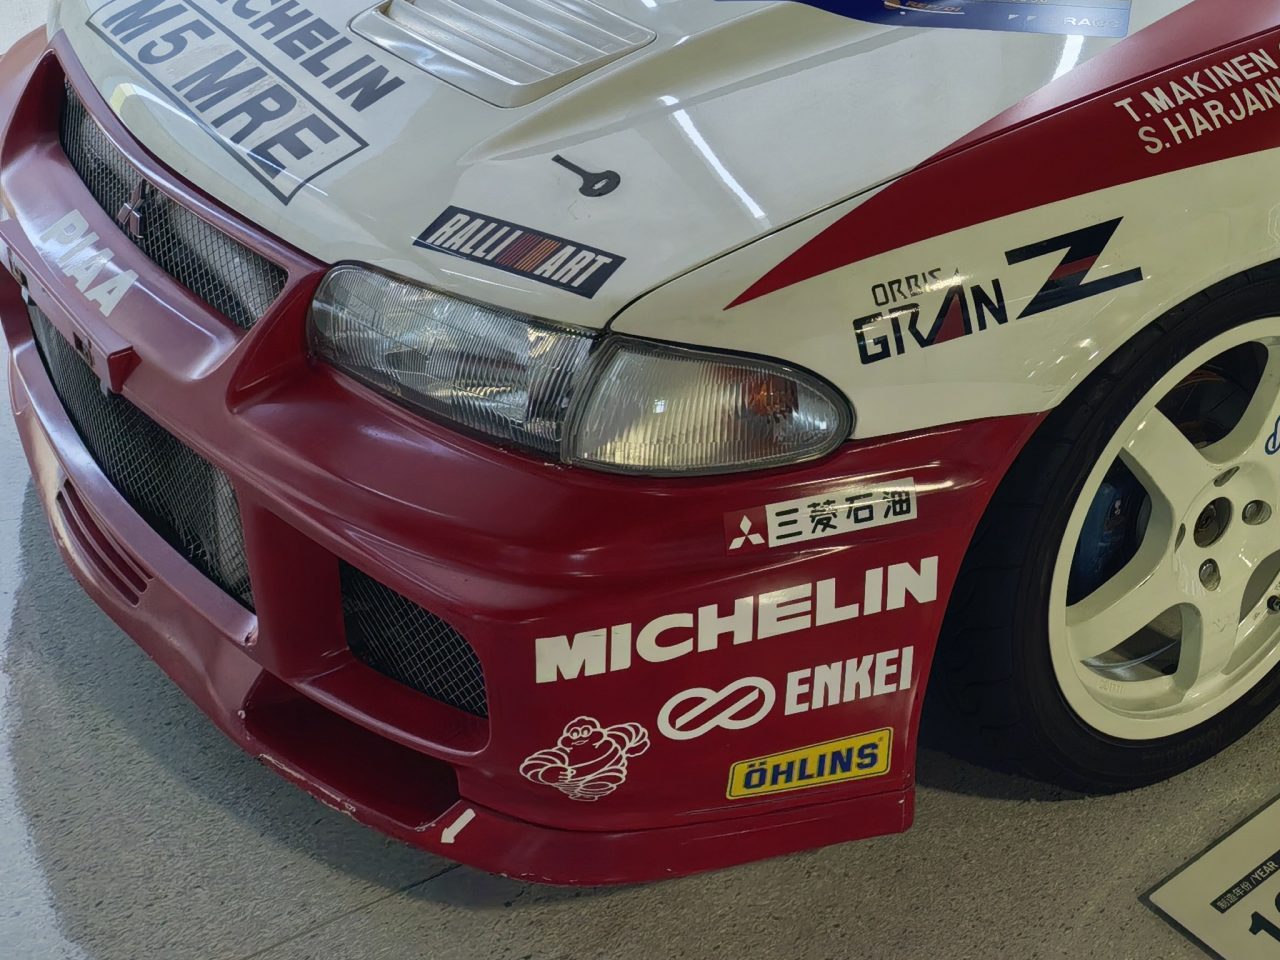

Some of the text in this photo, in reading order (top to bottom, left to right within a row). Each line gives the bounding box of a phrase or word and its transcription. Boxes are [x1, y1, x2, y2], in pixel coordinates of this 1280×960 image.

[173, 50, 340, 179] MRE
[1114, 48, 1274, 123] T.MAKINEN
[39, 209, 139, 317] PIAA
[428, 213, 612, 290] RALLI ART
[871, 268, 942, 307] ORBIS
[853, 216, 1143, 364] GRAN Z
[774, 486, 912, 538] 三菱石油
[536, 555, 938, 684] MICHELIN
[784, 645, 914, 715] ENKEI
[743, 740, 880, 789] ÖHLINS
